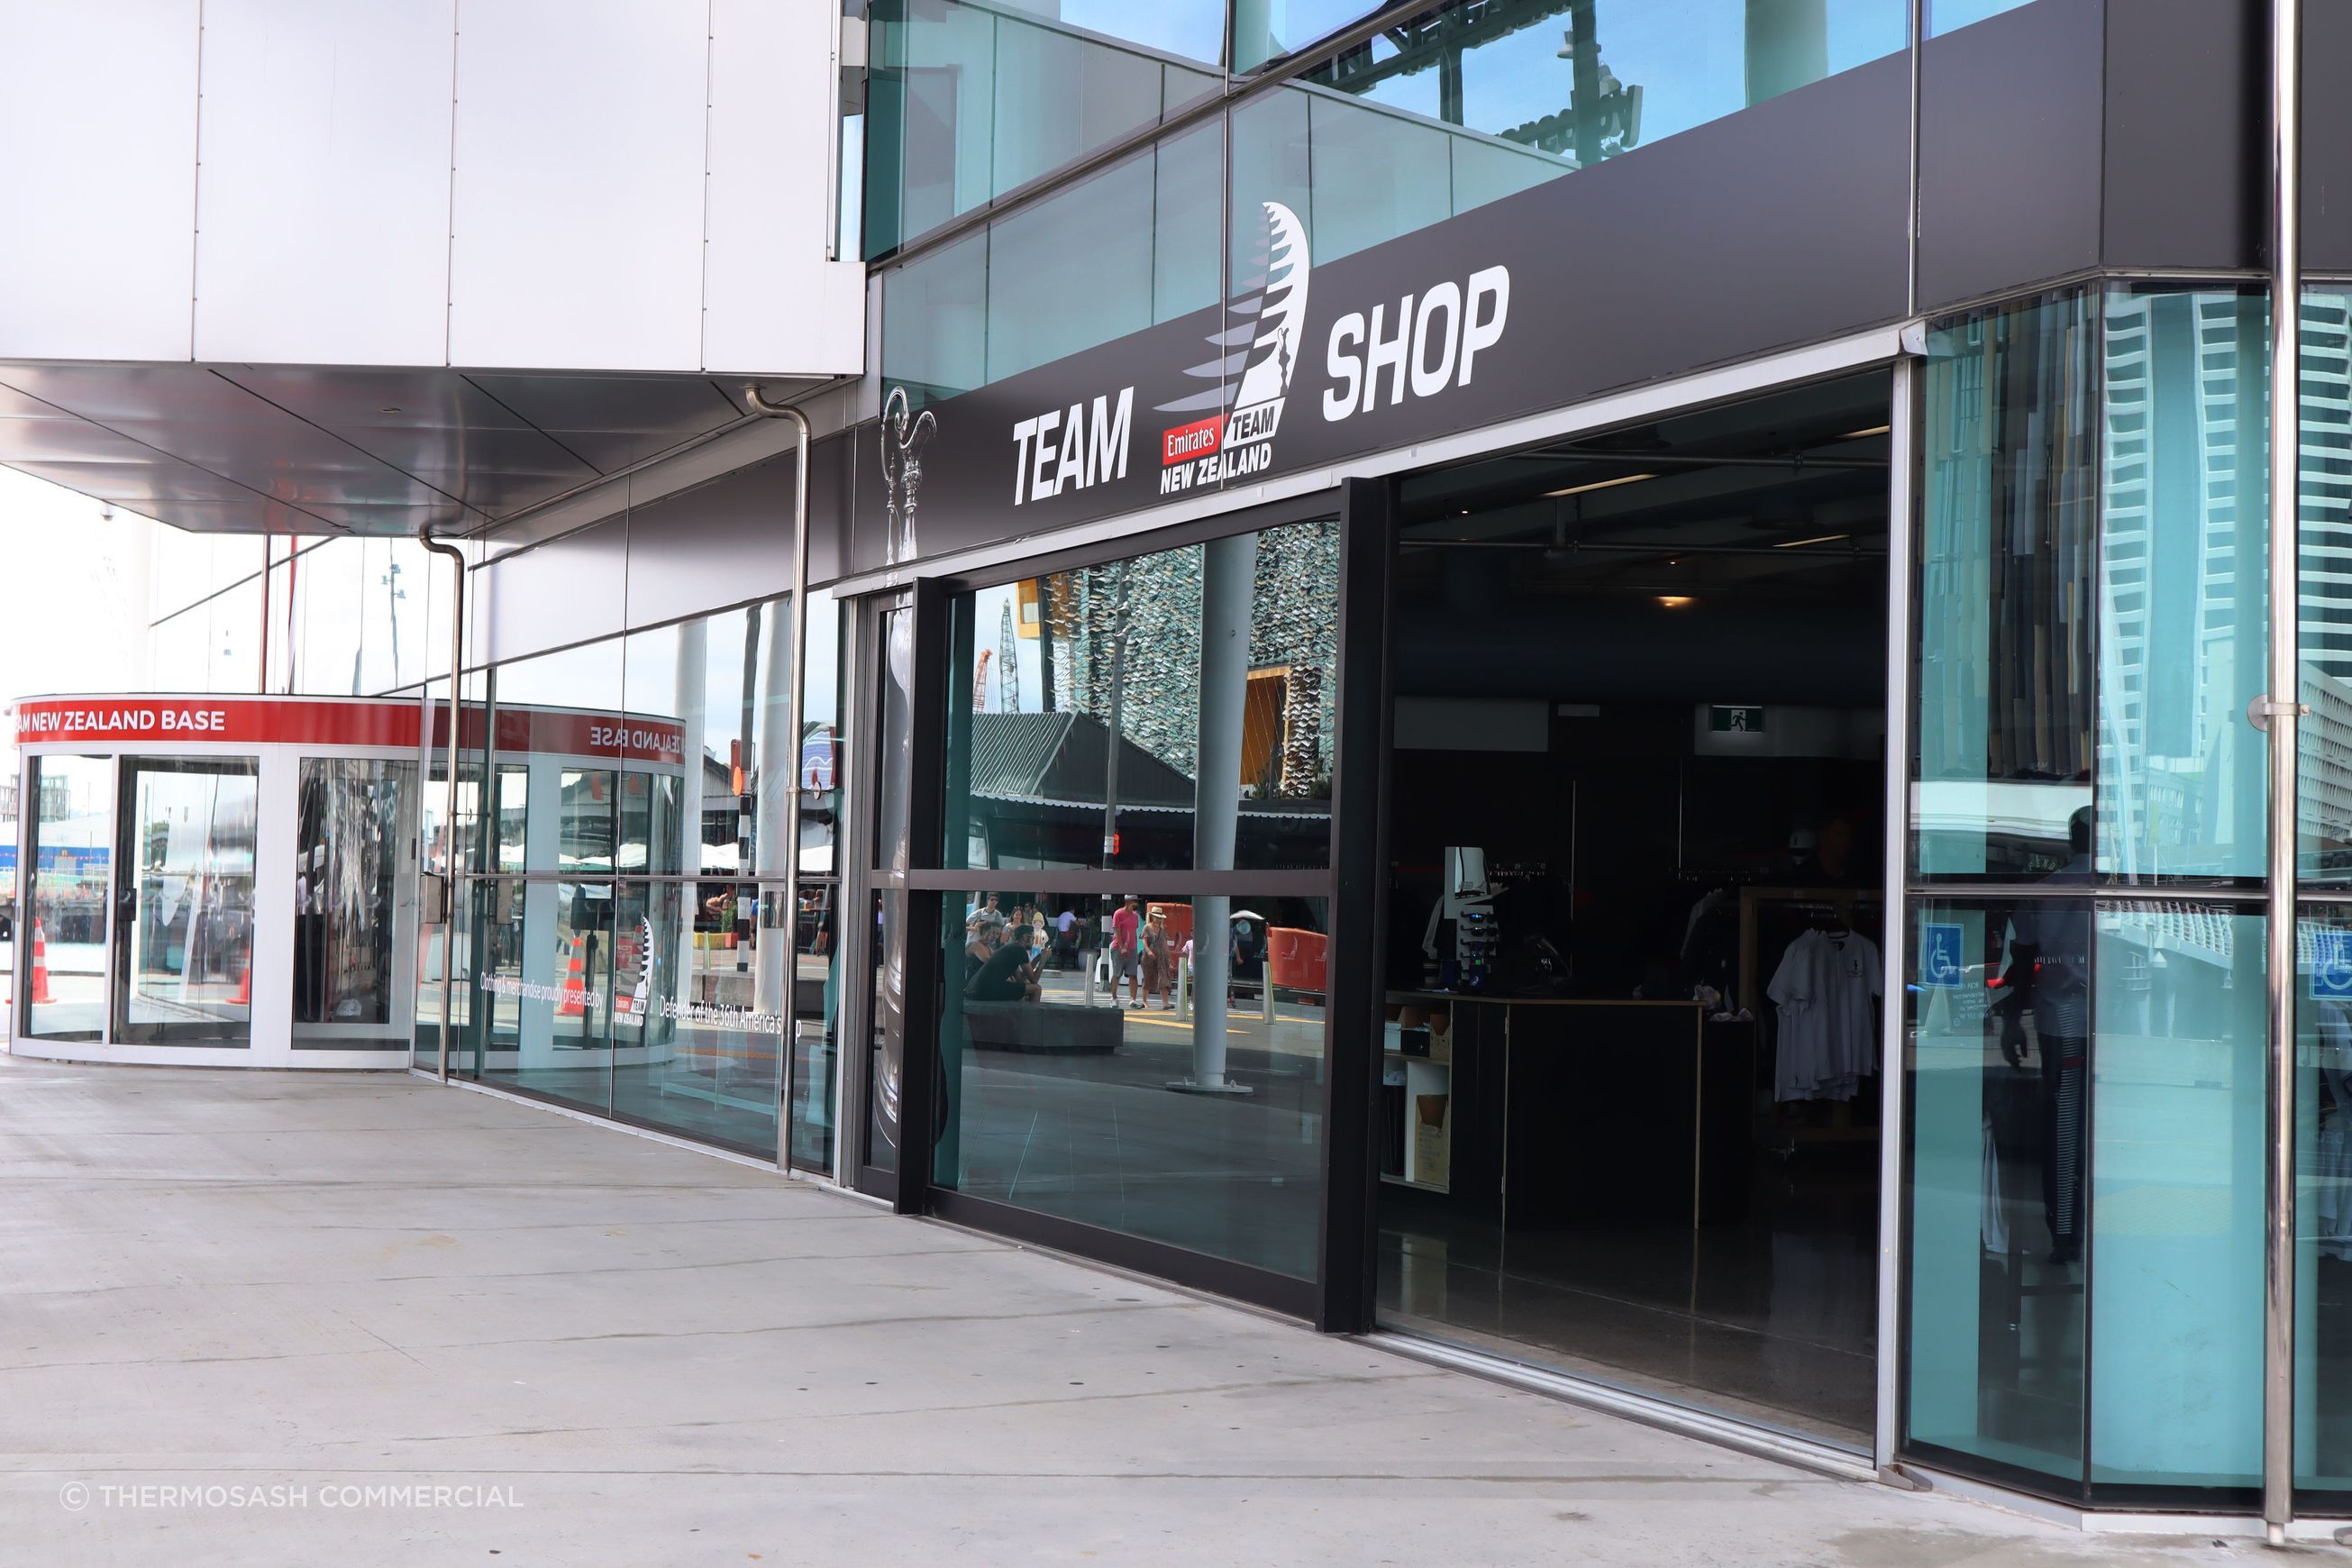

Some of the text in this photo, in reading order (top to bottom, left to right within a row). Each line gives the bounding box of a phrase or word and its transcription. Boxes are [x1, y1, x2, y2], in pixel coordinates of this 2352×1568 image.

[1323, 265, 1510, 422] SHOP
[1167, 426, 1215, 457] Emirates
[1233, 406, 1275, 442] TEAM
[1013, 386, 1134, 506] TEAM
[1160, 442, 1272, 495] NEW ZEALAND
[32, 711, 61, 732] NEW
[64, 710, 155, 731] ZEALAND
[160, 710, 225, 731] BASE
[480, 971, 502, 998] Clothing
[542, 982, 563, 1007] proudly
[563, 986, 595, 1006] presented
[594, 988, 604, 1013] by
[660, 995, 694, 1023] Defender
[705, 1003, 718, 1026] the
[719, 1004, 739, 1027] 36th
[740, 1005, 782, 1035] America's
